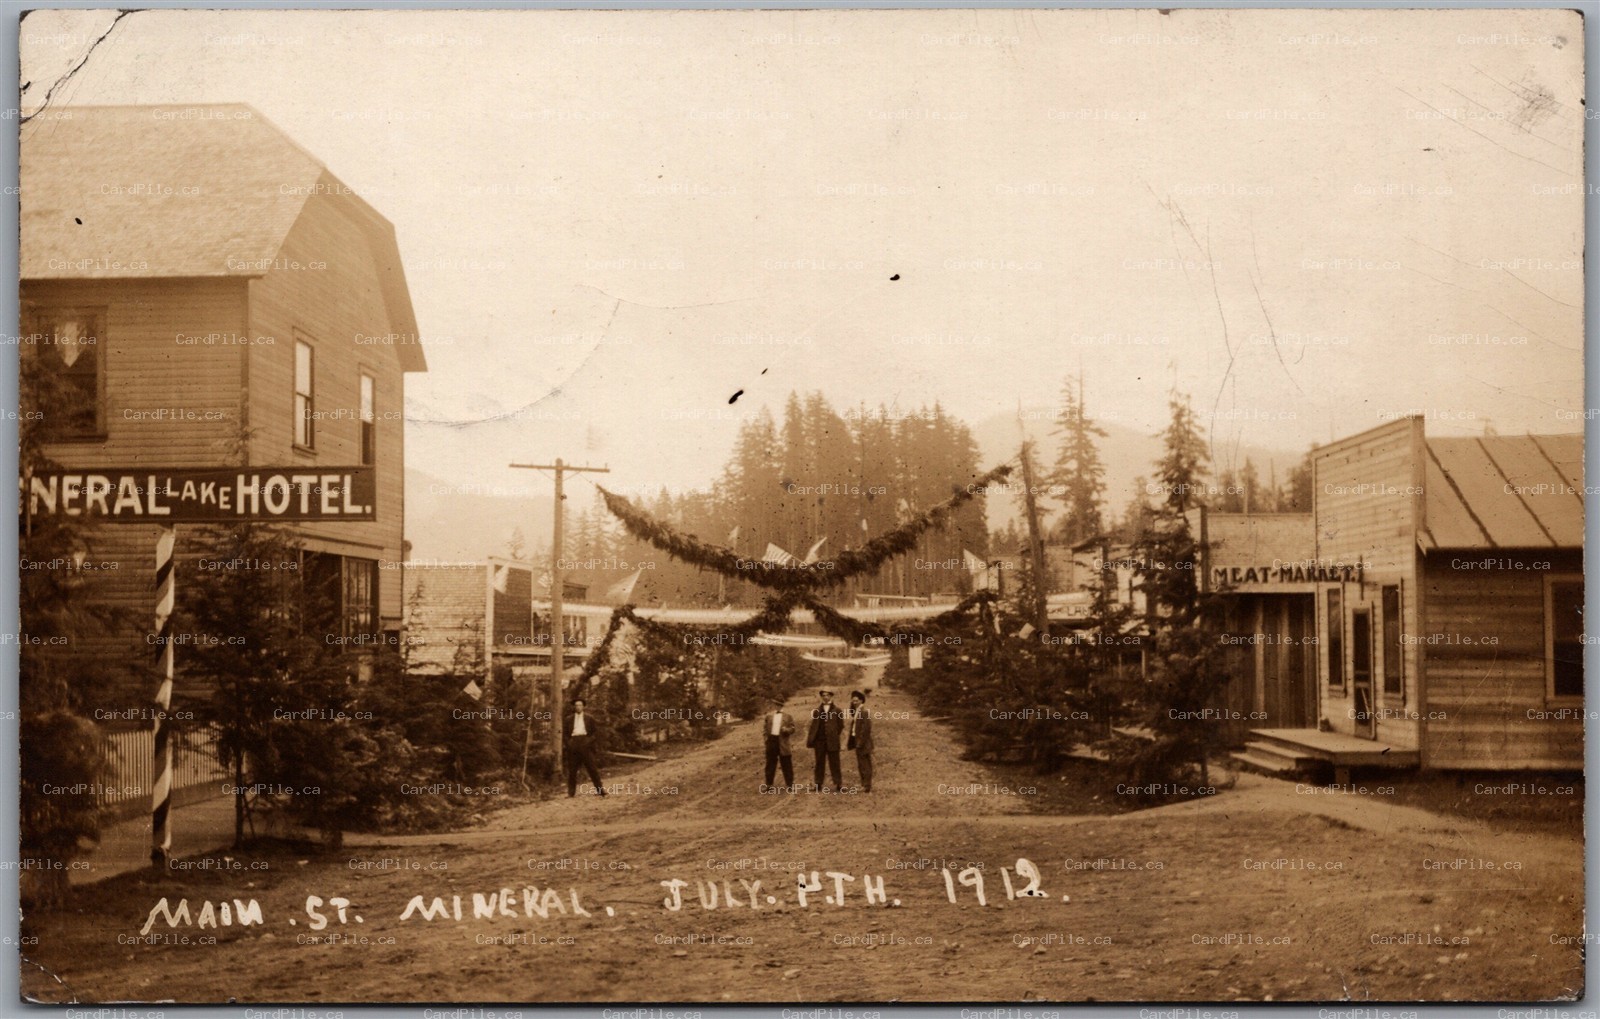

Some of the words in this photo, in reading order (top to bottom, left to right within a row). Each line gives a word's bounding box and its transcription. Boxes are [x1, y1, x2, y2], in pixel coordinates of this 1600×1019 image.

[166, 477, 232, 510] LAKE
[236, 474, 373, 515] HOTEL.
[140, 897, 264, 936] MAIN
[400, 886, 615, 921] MINERAL.
[660, 878, 777, 911] JULY.
